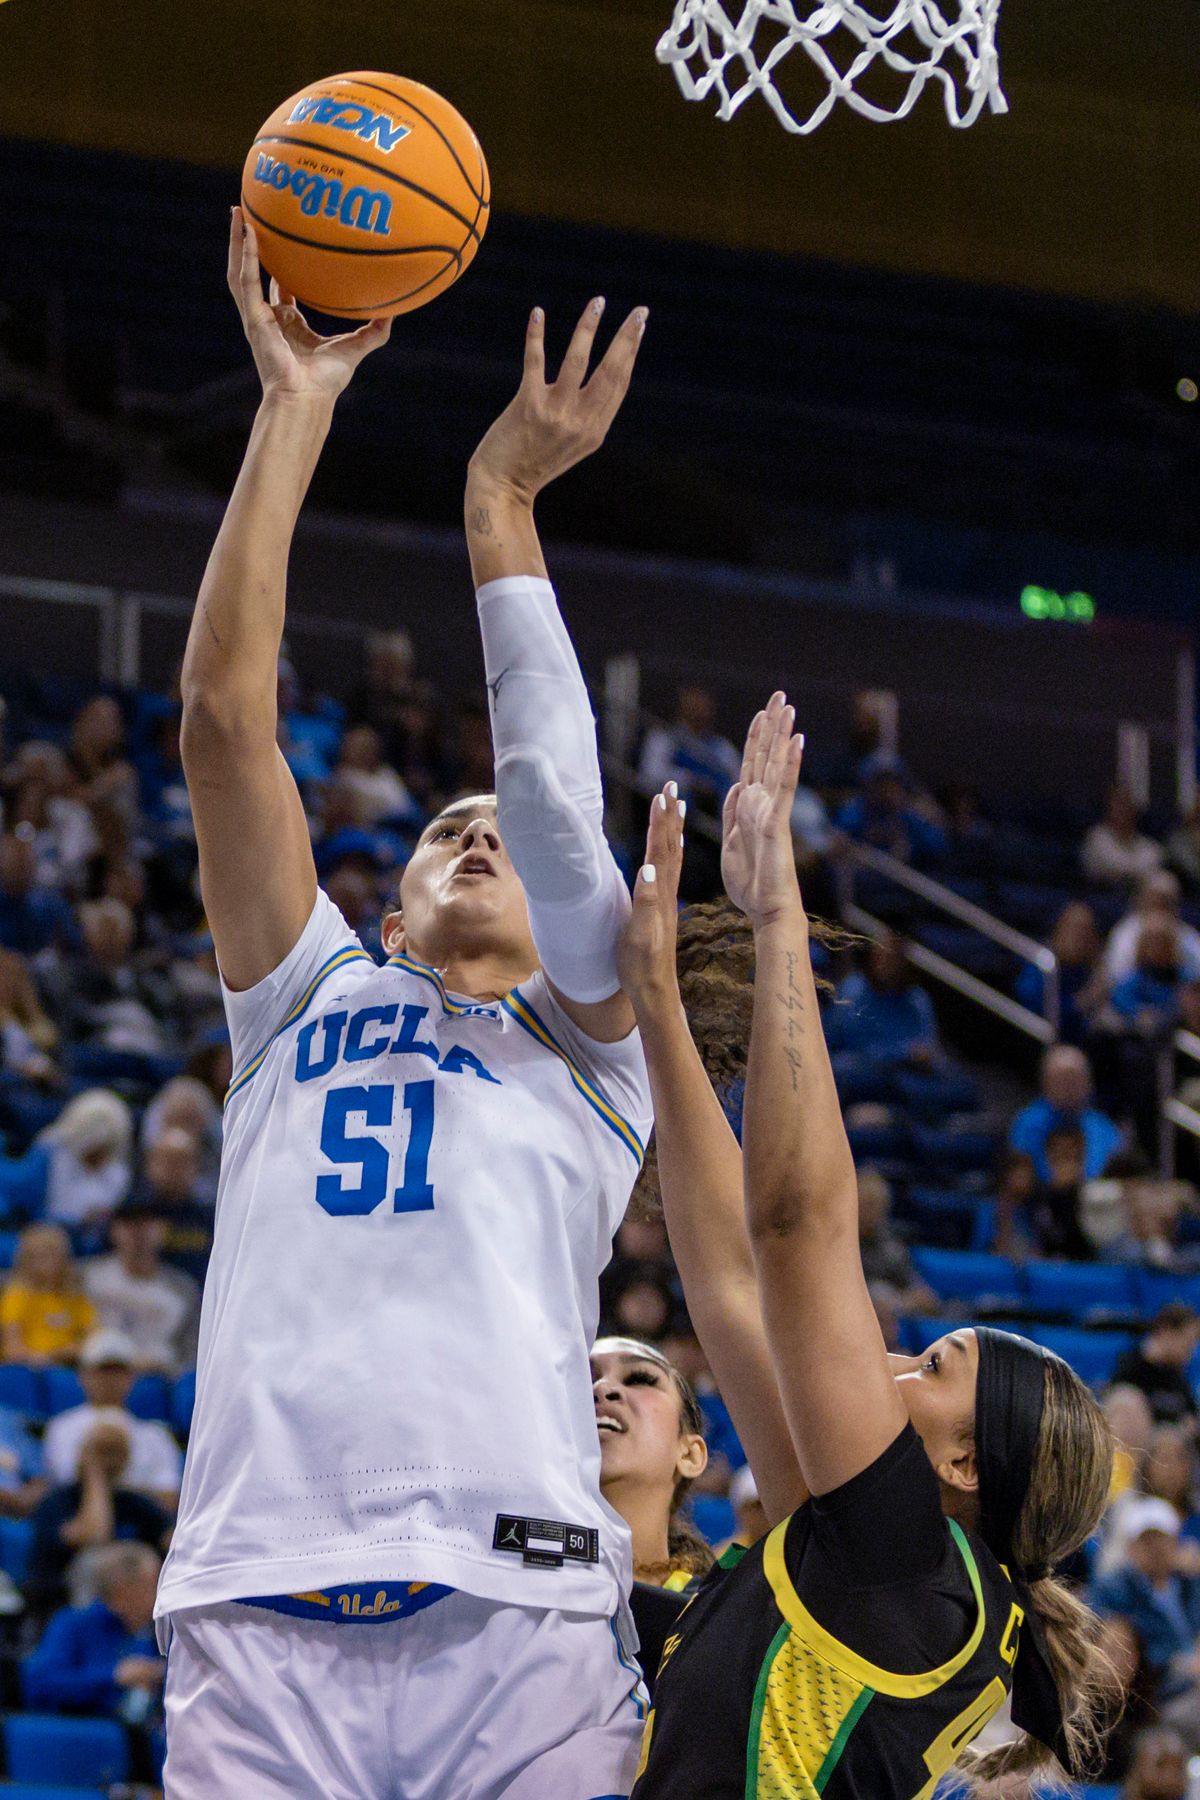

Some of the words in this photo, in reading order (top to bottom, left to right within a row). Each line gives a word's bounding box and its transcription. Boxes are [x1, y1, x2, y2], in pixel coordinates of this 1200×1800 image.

[286, 97, 413, 155] NCAA
[253, 151, 394, 236] Wilson
[320, 165, 345, 178] EVO
[295, 1003, 503, 1085] UCLA
[315, 1079, 435, 1217] 51
[569, 1534, 585, 1550] 50
